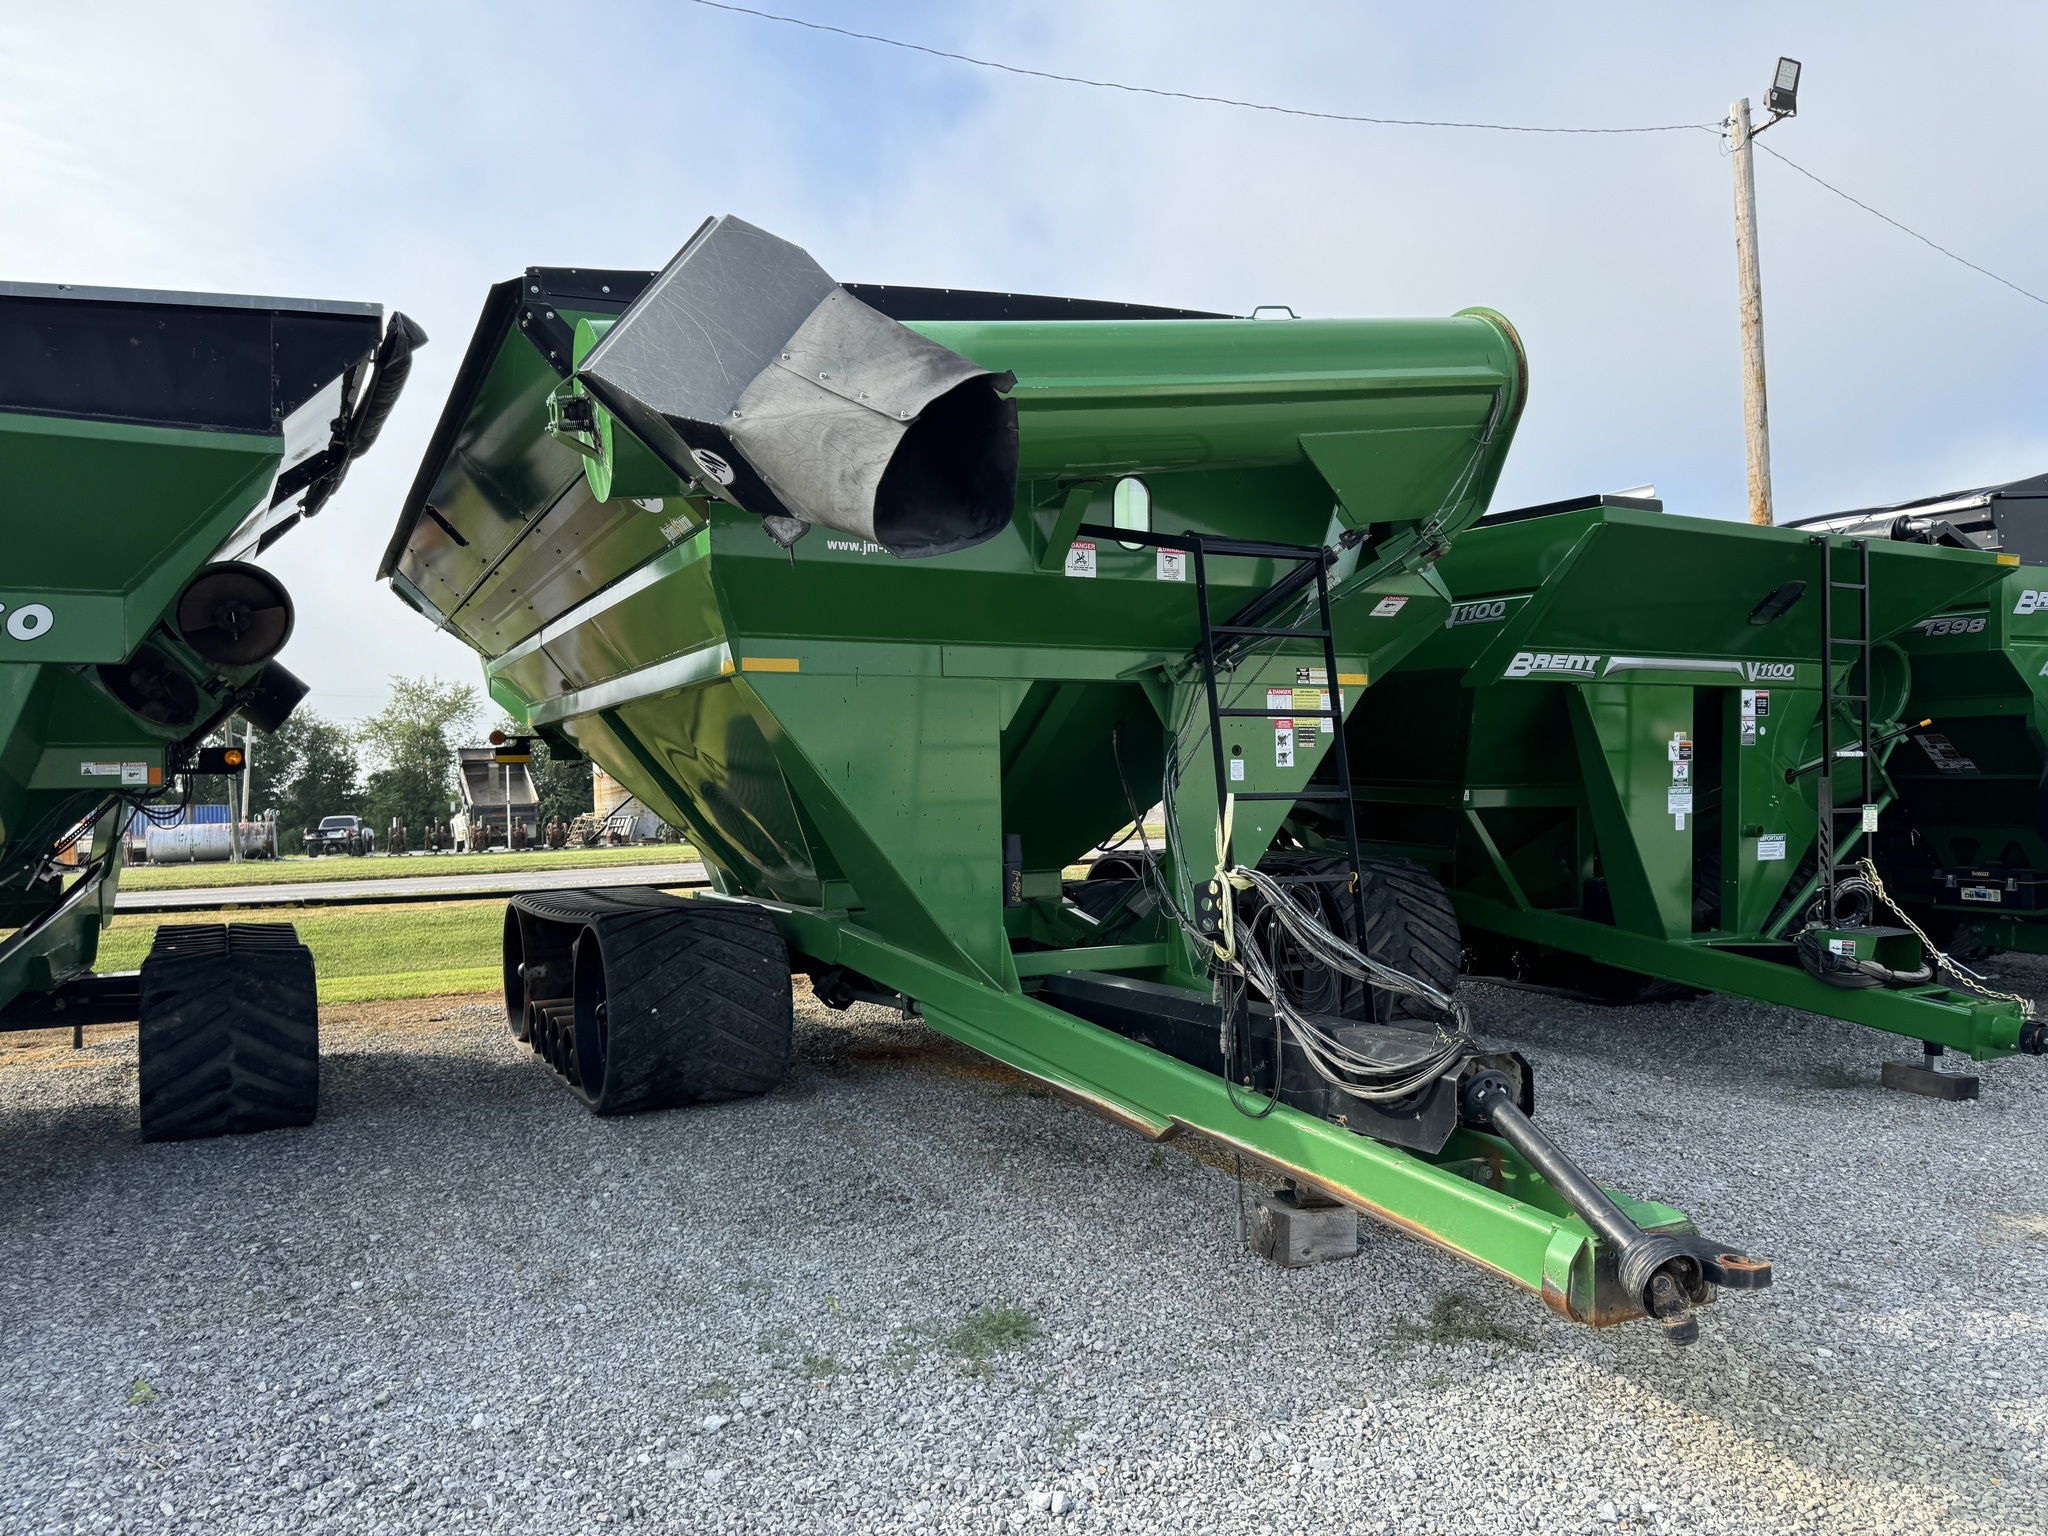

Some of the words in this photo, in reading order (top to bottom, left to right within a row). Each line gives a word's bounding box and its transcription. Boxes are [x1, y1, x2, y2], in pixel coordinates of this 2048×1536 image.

[1071, 542, 1096, 550] DANGER
[1925, 618, 1987, 637] 1398
[1503, 652, 1602, 678] BRENT
[1746, 662, 1796, 682] V1100
